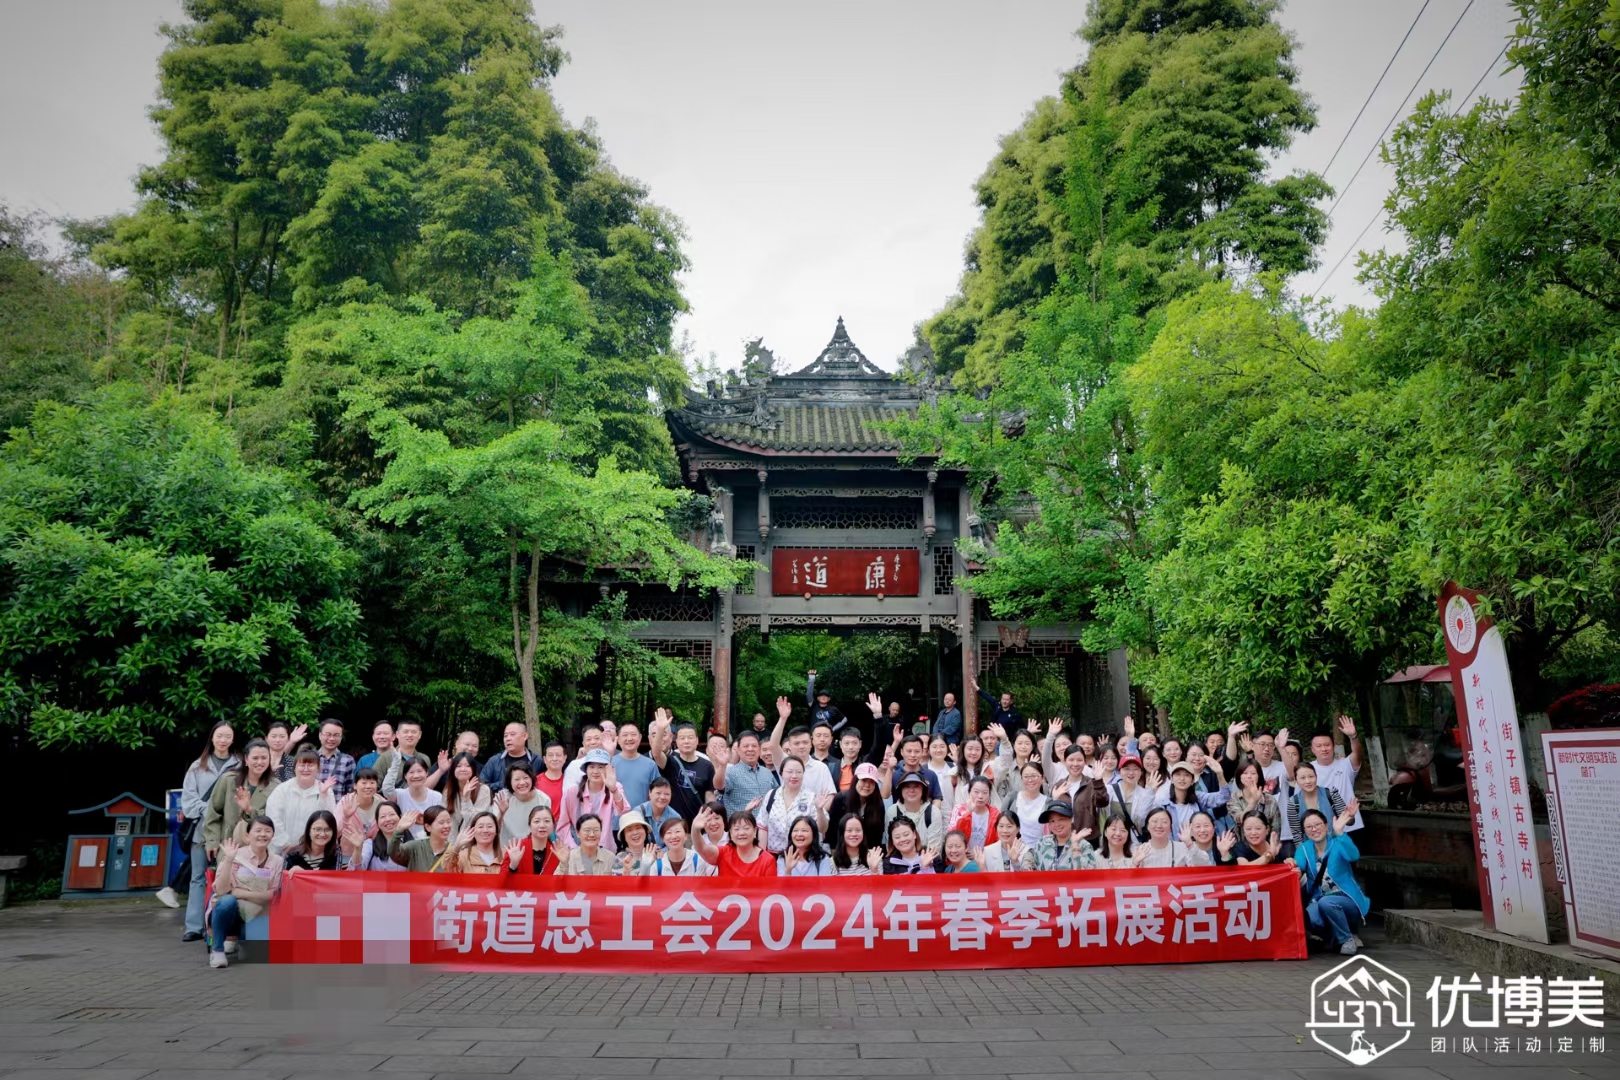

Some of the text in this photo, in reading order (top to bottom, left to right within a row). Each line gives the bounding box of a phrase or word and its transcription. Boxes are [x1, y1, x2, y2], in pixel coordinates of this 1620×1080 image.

[1558, 752, 1618, 764] 新时代文明实践站
[1581, 766, 1597, 779] 简介
[1472, 673, 1513, 916] 新时代文明实践健康广场
[1501, 722, 1534, 880] 街子镇古寺村
[430, 884, 1271, 955] 街道总工会2024年春季拓展活动
